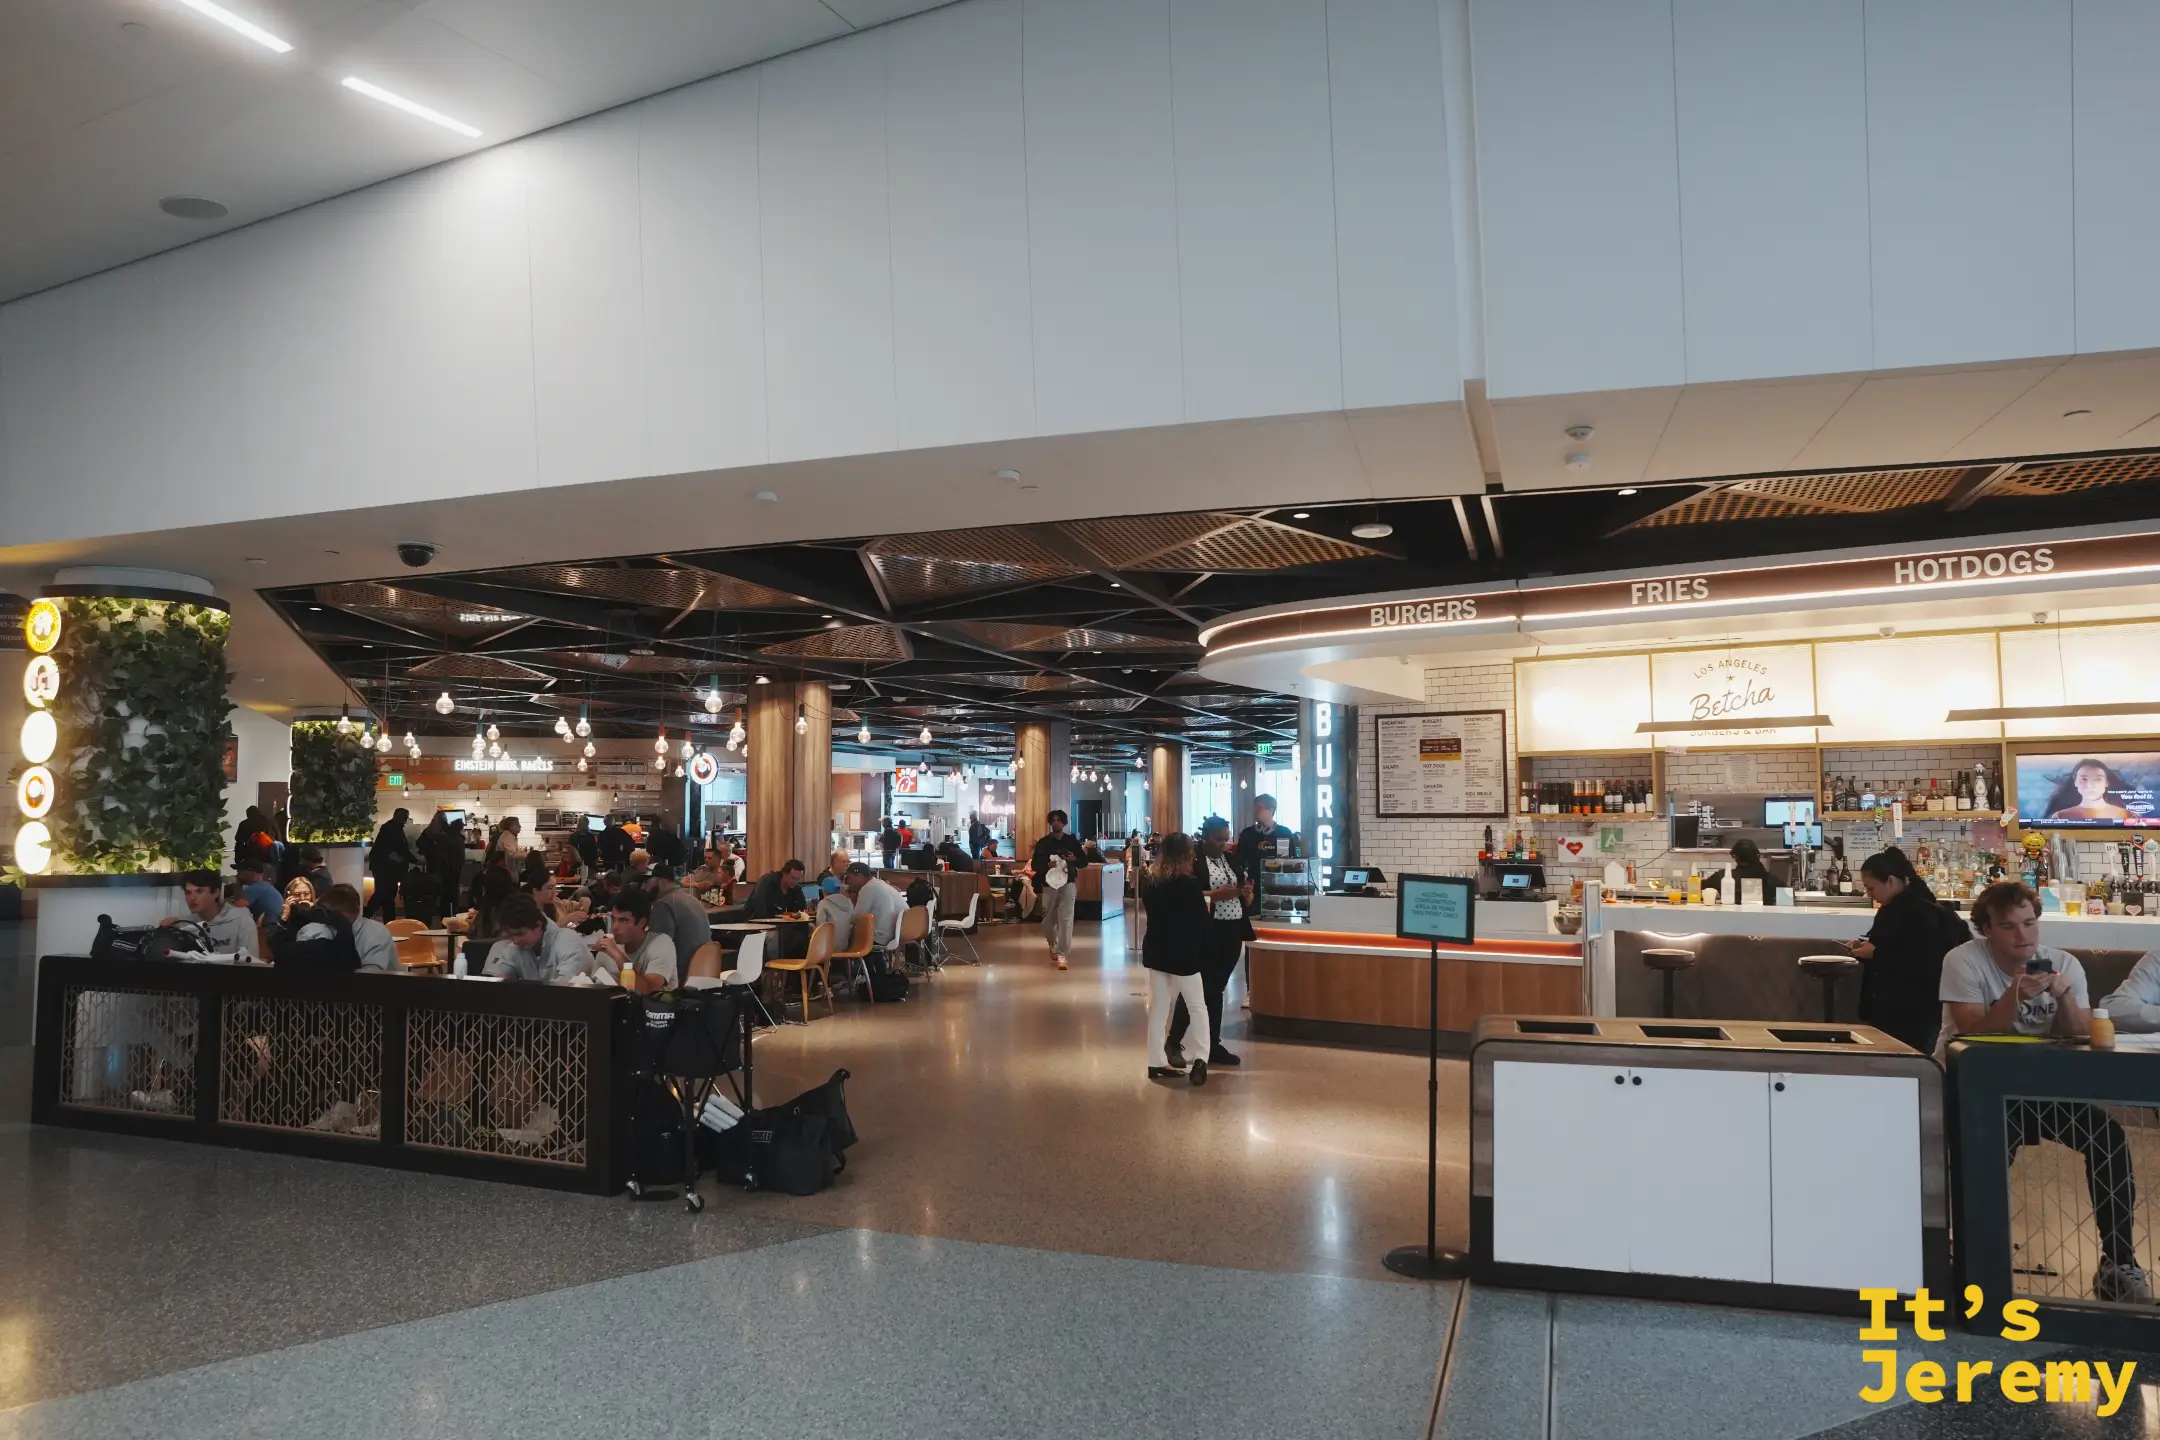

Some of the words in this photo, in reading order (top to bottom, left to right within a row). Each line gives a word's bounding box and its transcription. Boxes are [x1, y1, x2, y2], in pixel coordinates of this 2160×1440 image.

[1894, 548, 2055, 584] HOTDOGS
[1630, 578, 1709, 605] FRIES
[1370, 599, 1477, 627] BURGERS
[1693, 663, 1714, 679] LOS
[1718, 659, 1768, 675] ANGELES
[1690, 678, 1775, 721] Betcha
[455, 760, 494, 771] EINSTEIN
[389, 775, 402, 785] EXIT
[1604, 833, 1616, 848] A
